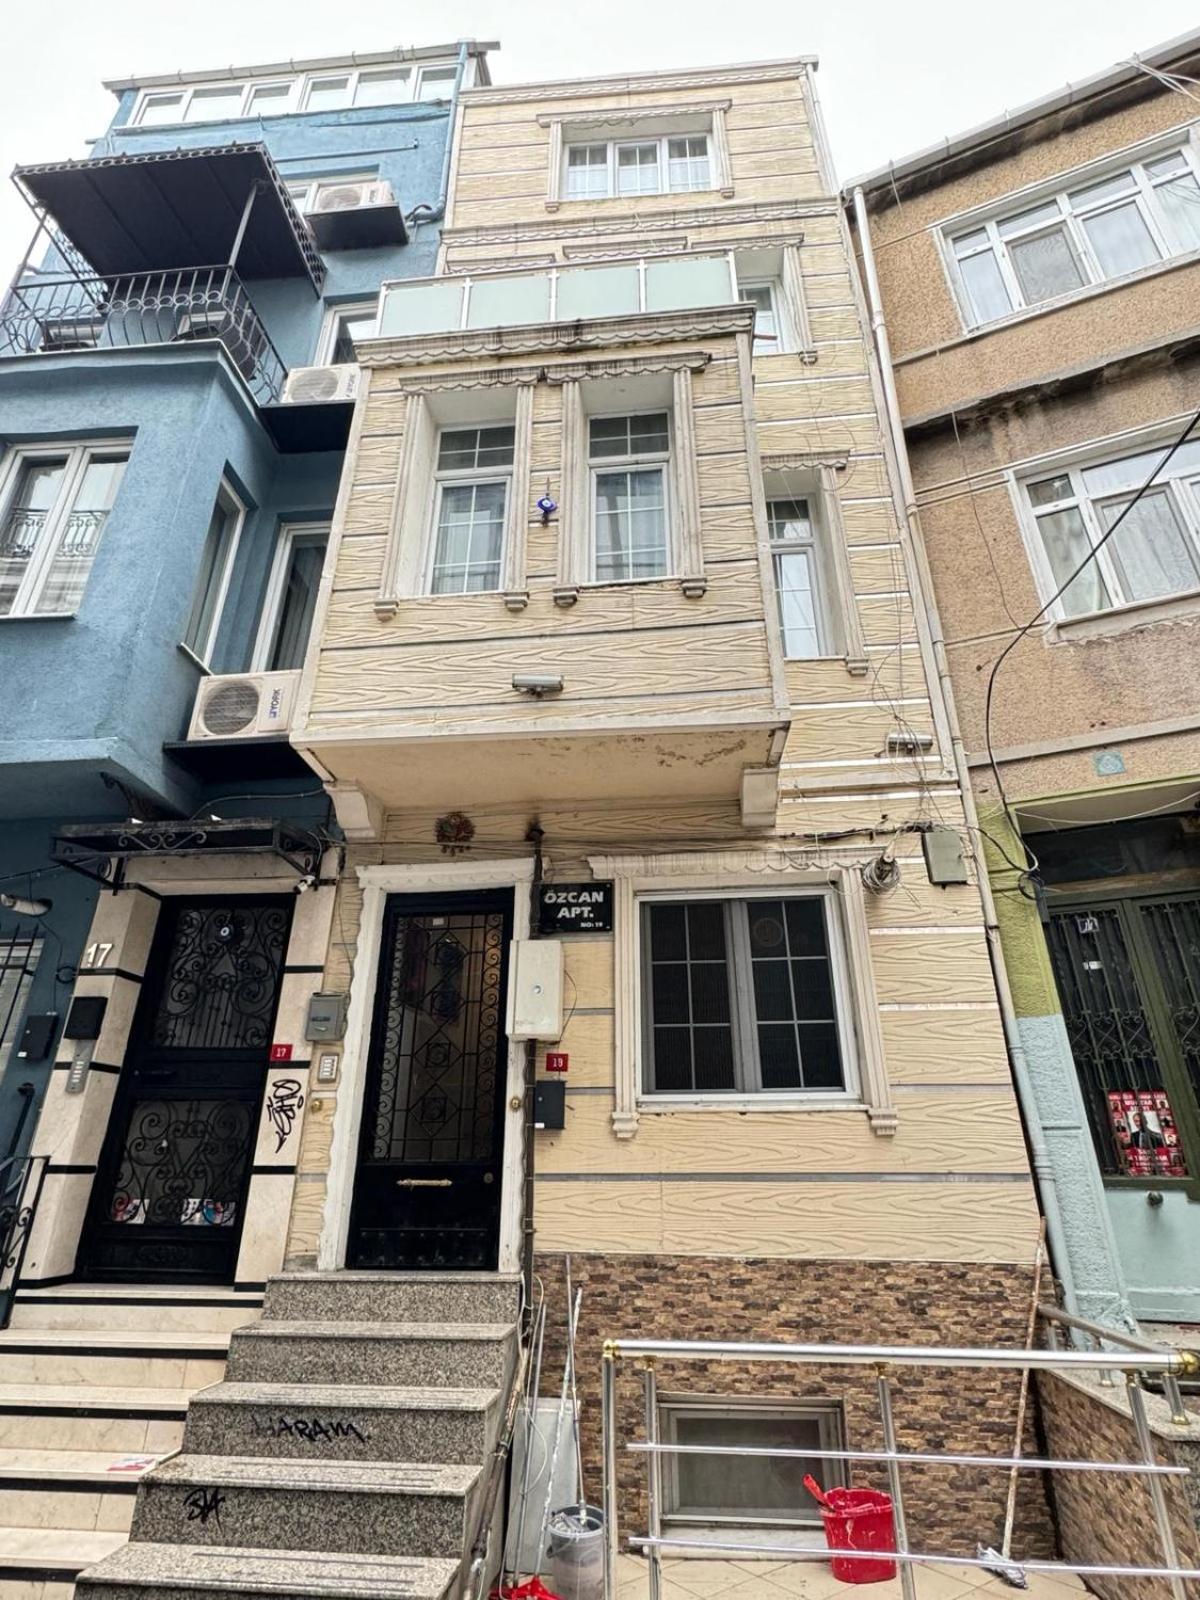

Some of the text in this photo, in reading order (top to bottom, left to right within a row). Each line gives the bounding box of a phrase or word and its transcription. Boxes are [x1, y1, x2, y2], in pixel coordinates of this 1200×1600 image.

[544, 890, 604, 904] ÖZCAN
[557, 907, 594, 919] APT.
[86, 943, 114, 968] 17
[276, 1047, 287, 1058] 17
[553, 1057, 564, 1068] 19
